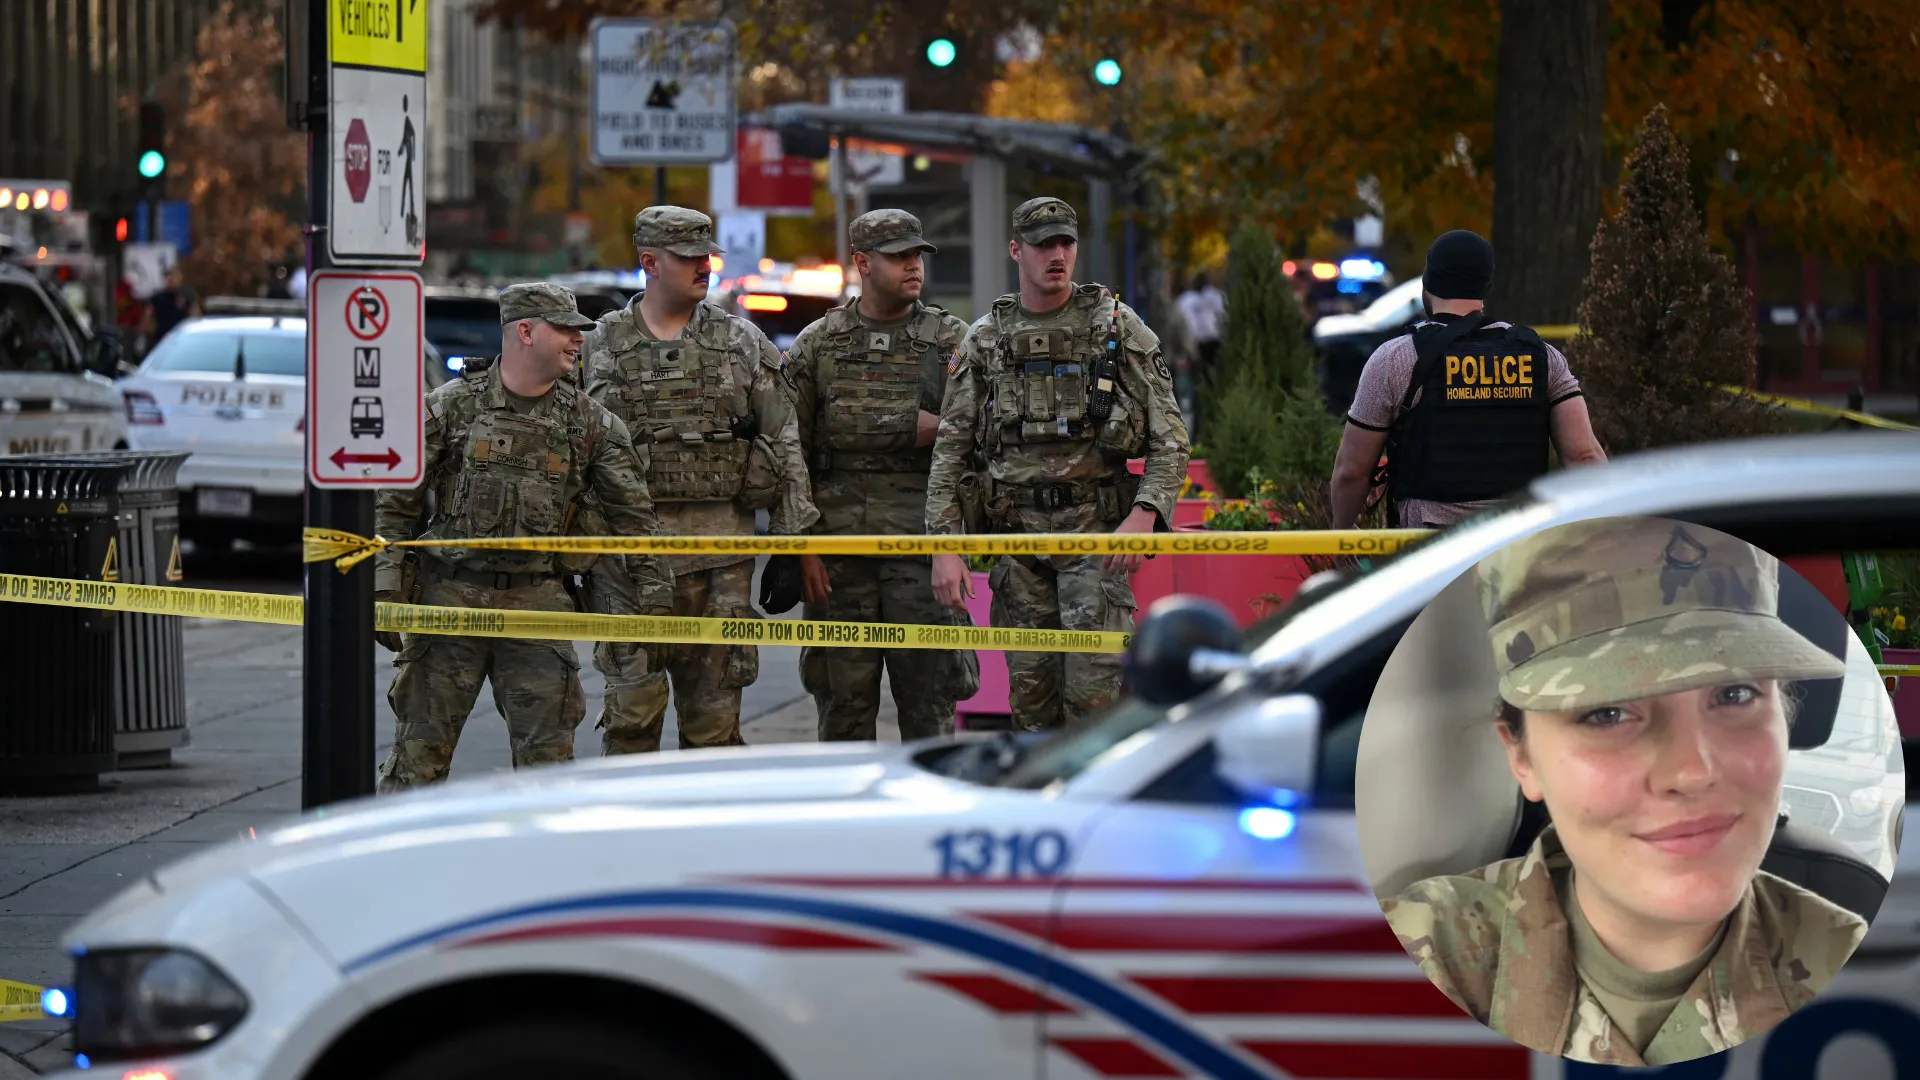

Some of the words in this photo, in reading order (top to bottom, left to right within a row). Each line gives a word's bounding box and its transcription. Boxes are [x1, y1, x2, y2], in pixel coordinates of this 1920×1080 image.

[340, 0, 390, 39] VEHICLES
[650, 113, 672, 131] TO
[347, 144, 368, 171] STOP
[378, 149, 391, 175] FOR
[356, 349, 378, 377] M
[650, 370, 670, 379] HART
[1445, 355, 1533, 385] POLICE
[181, 385, 284, 410] POLICE
[1446, 387, 1491, 400] HOMELAND
[1493, 387, 1533, 399] SECURITY
[930, 828, 1072, 877] 1310
